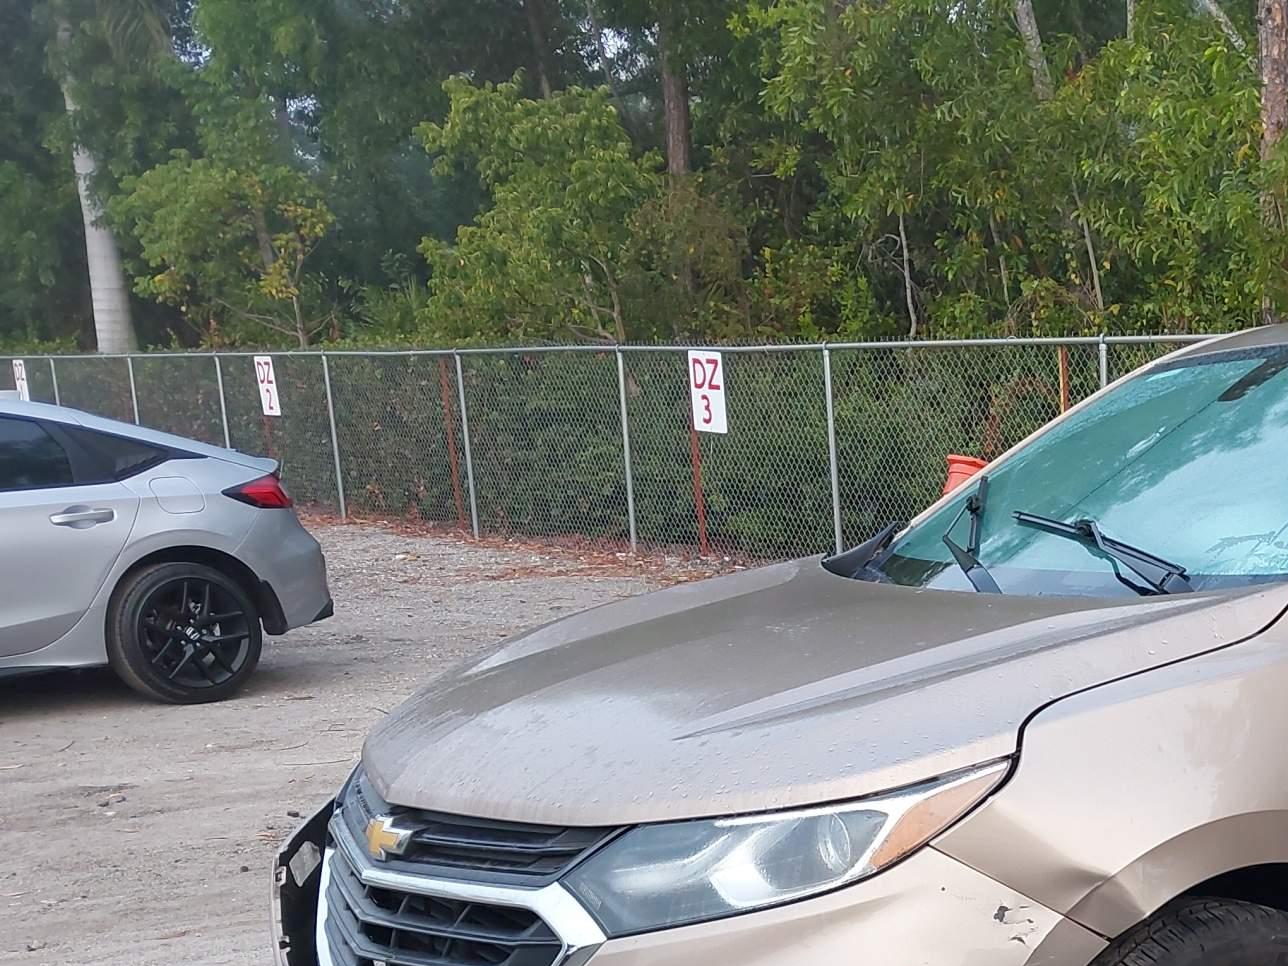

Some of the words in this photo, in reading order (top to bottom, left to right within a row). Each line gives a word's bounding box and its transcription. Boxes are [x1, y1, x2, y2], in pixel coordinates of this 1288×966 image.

[256, 361, 273, 384] DZ
[691, 358, 720, 390] DZ
[266, 388, 274, 410] 2
[701, 394, 712, 424] 3
